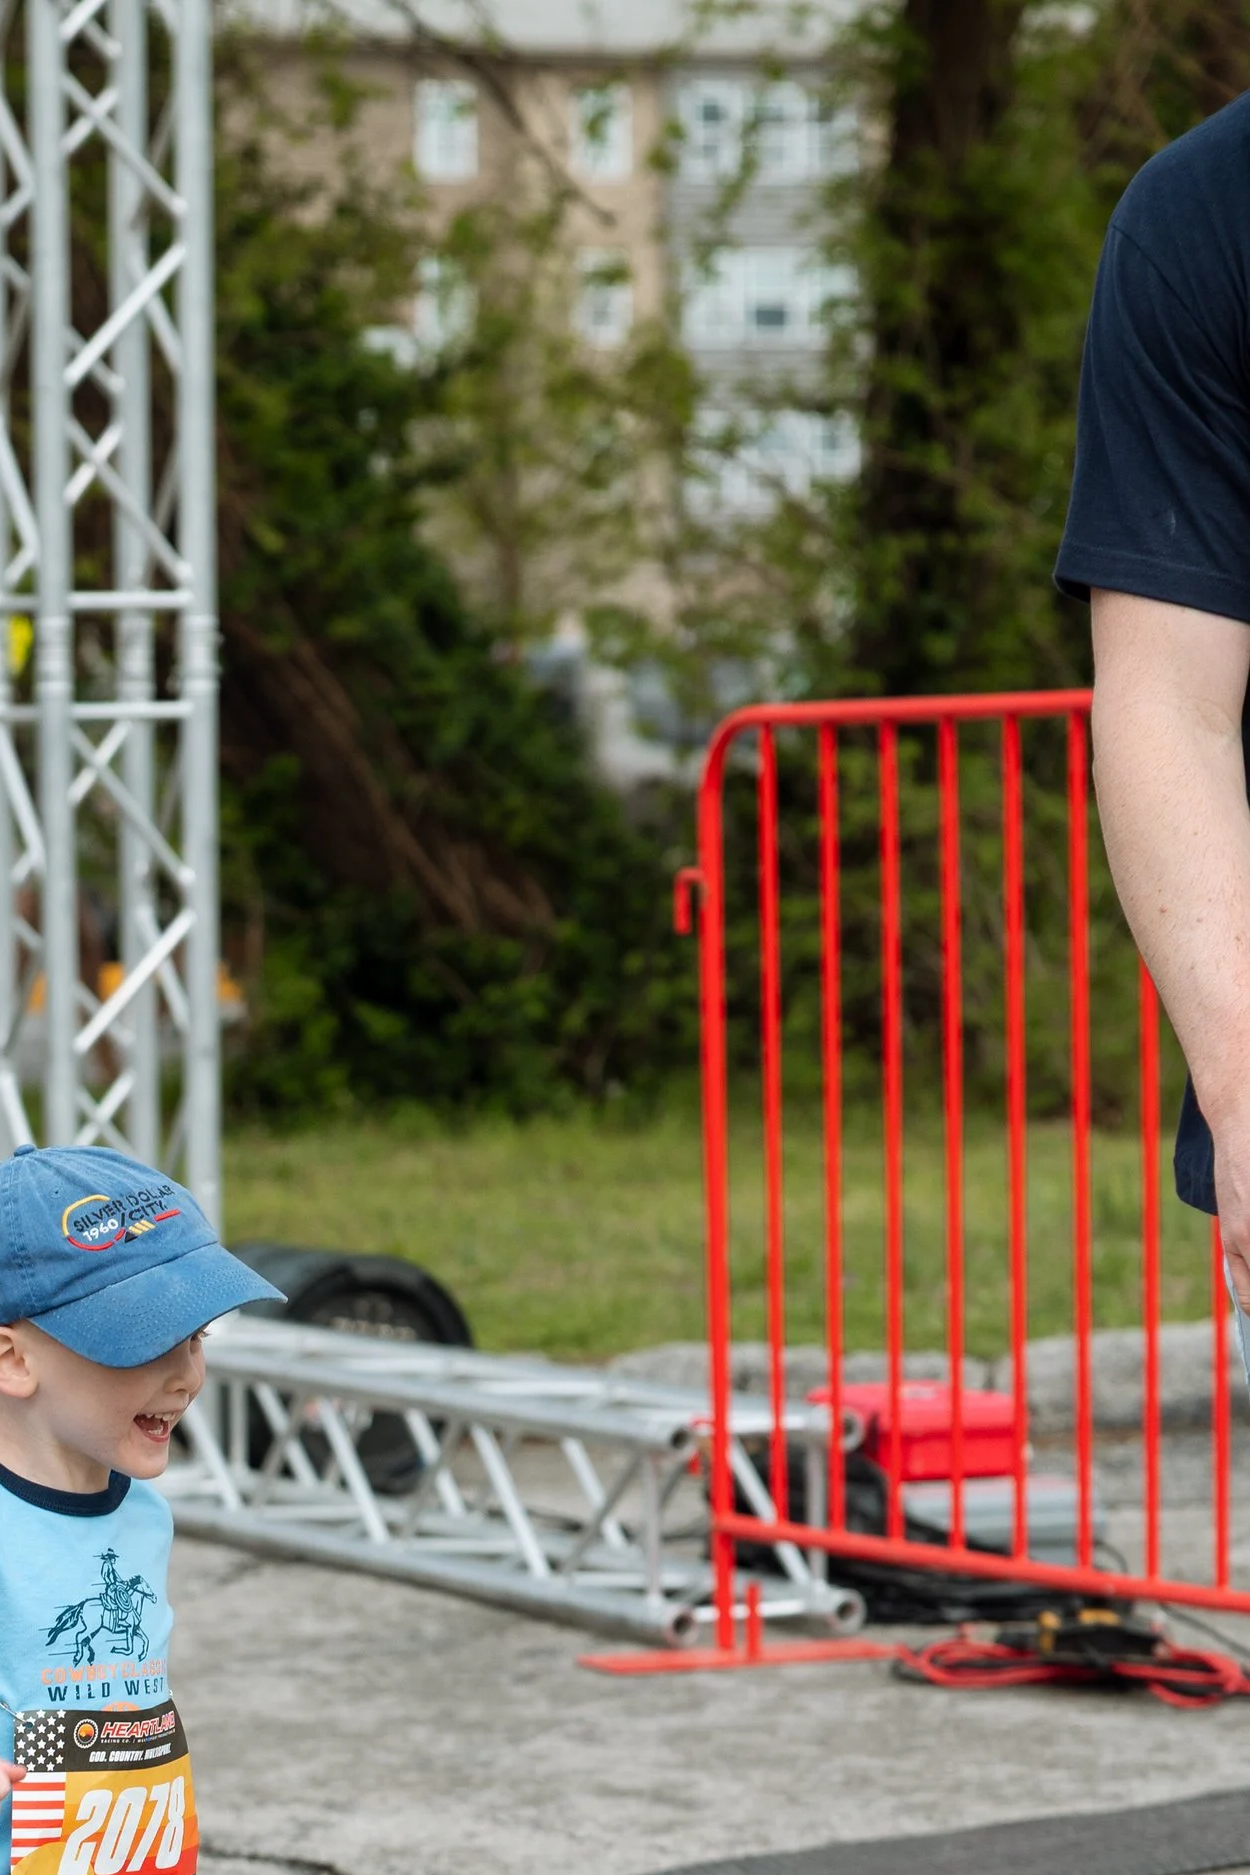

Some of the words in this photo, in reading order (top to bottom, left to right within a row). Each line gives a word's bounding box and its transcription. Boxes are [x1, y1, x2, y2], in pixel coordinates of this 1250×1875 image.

[73, 1199, 126, 1232] SILVER
[82, 1218, 119, 1242] 1960
[41, 1663, 118, 1685] COWBOY
[121, 1659, 166, 1678] CLASSI
[47, 1681, 111, 1702] WILD
[124, 1677, 164, 1697] WEST
[100, 1710, 176, 1739] HEARTLAND
[88, 1750, 108, 1763] GOD.
[108, 1750, 144, 1762] COUNTRY.
